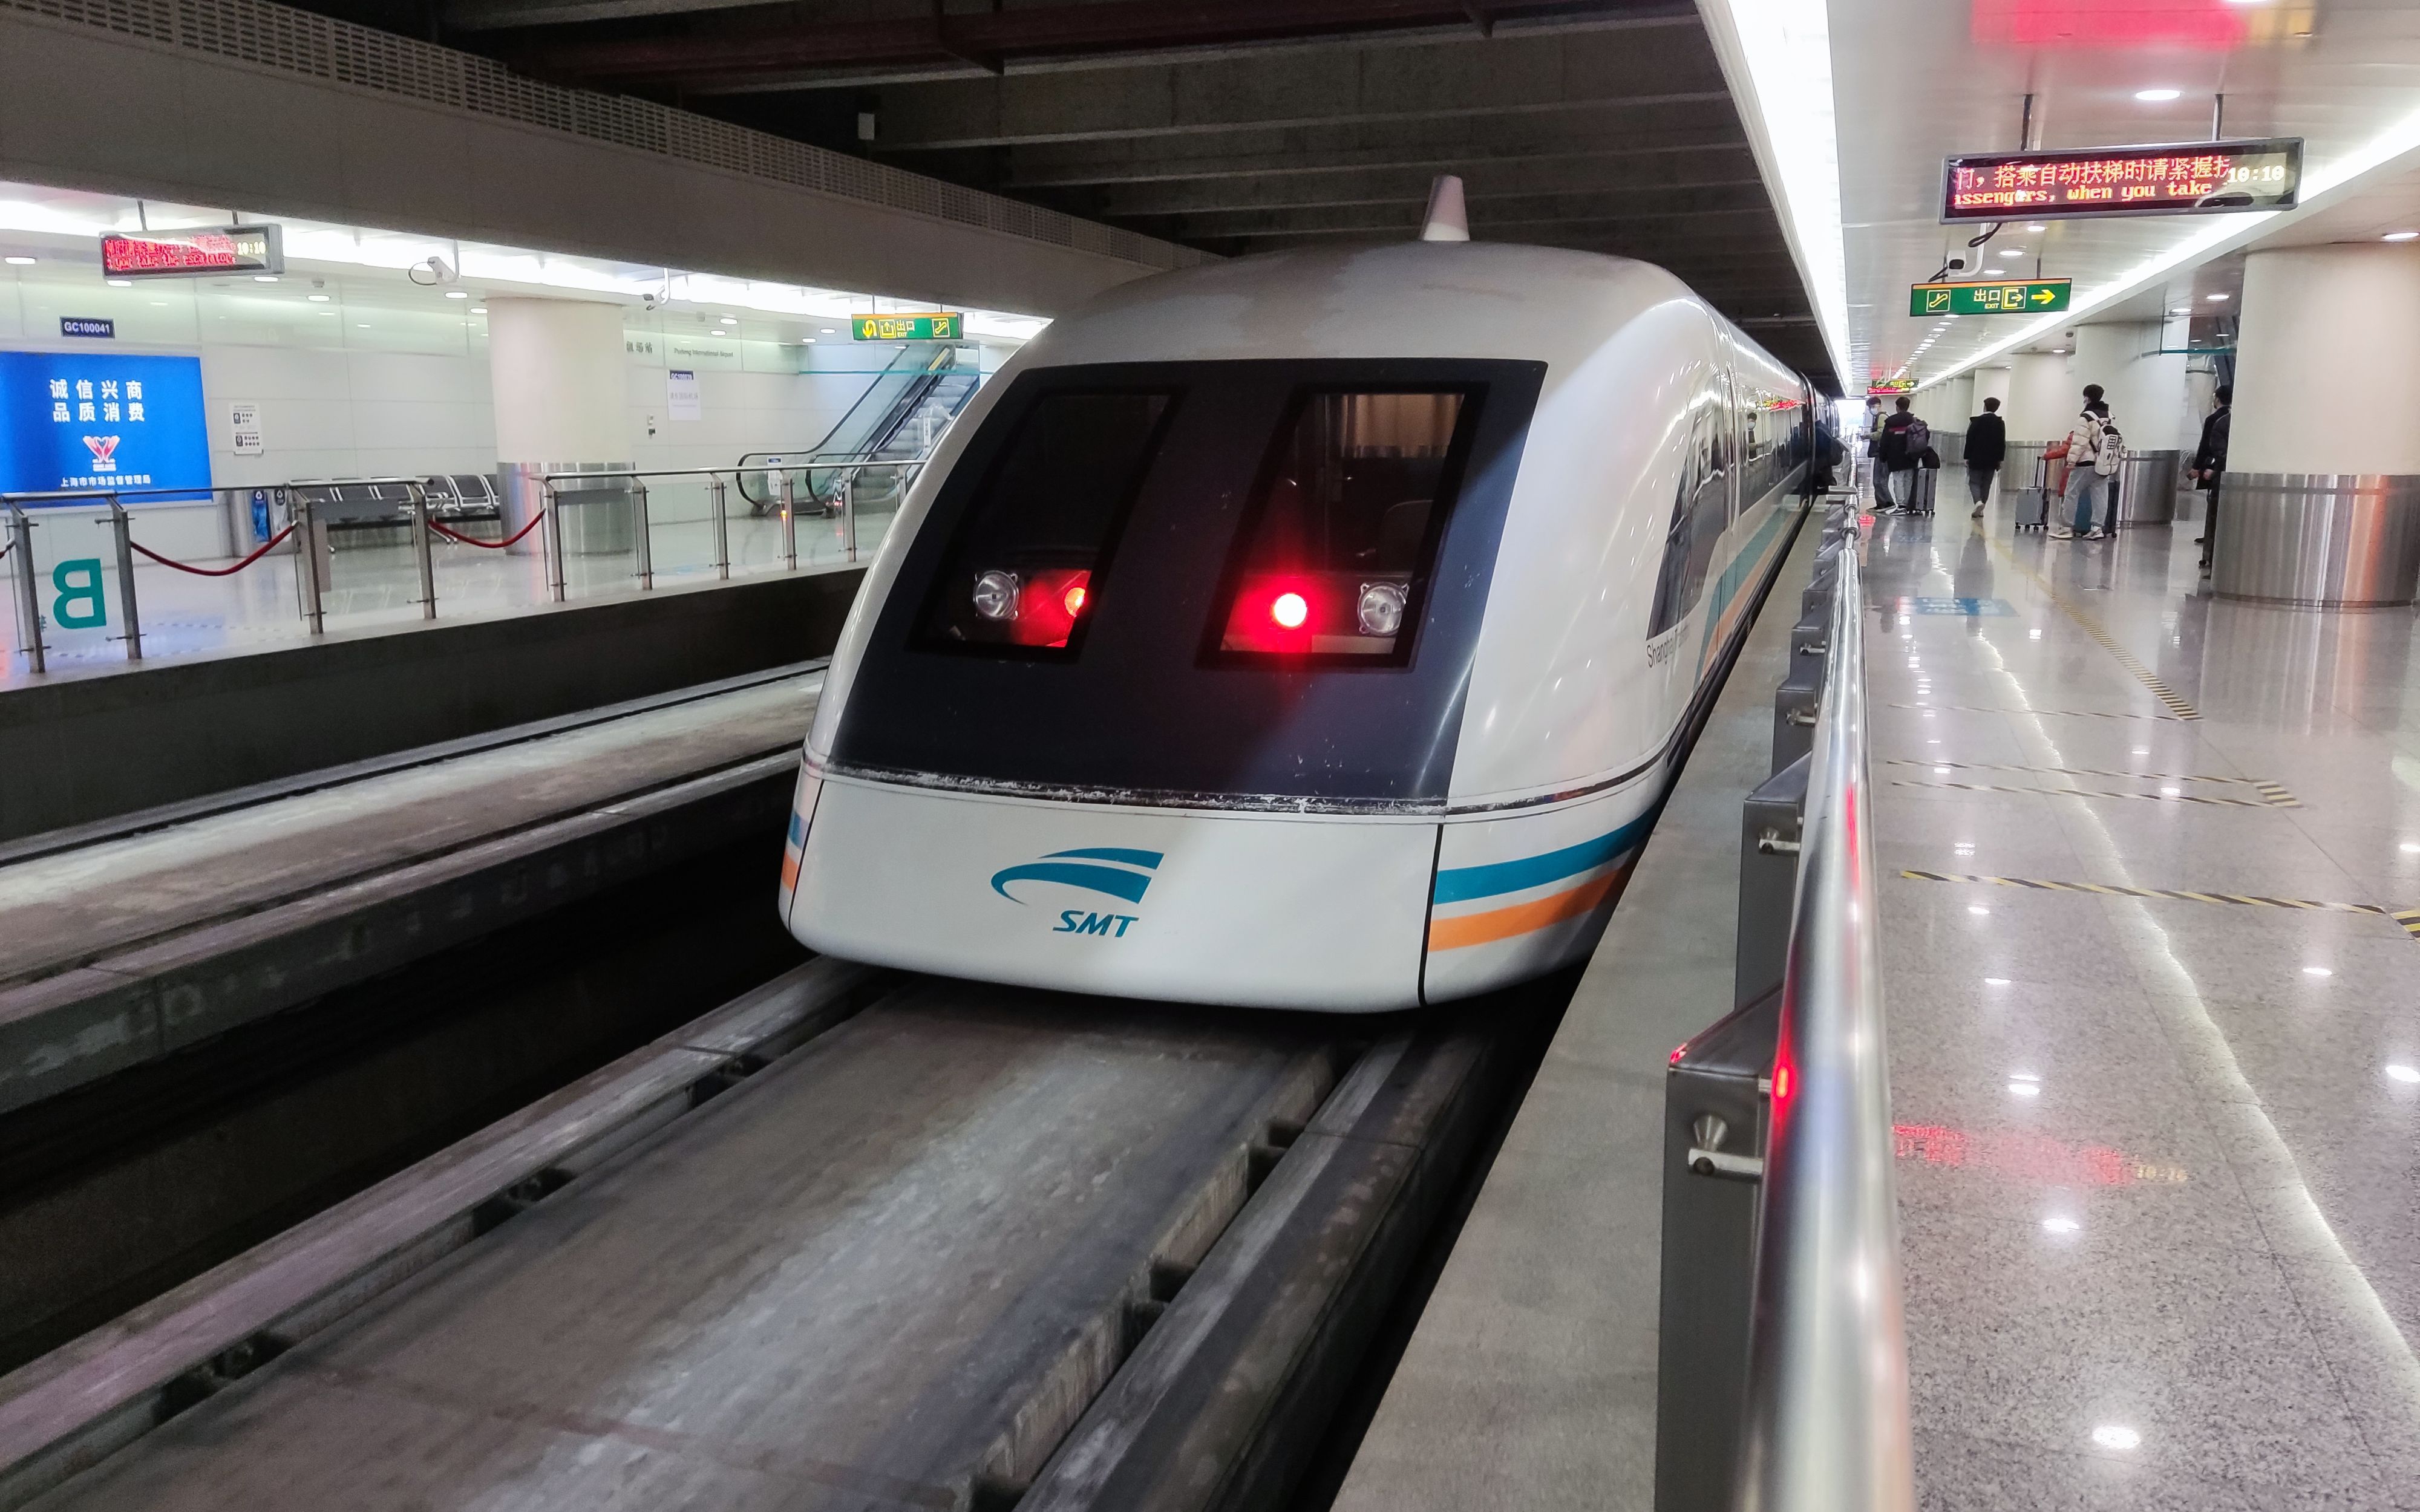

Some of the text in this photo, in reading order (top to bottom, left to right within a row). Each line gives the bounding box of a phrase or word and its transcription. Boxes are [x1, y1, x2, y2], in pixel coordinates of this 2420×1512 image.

[2227, 165, 2285, 183] 10:10
[2067, 184, 2113, 200] when
[2121, 185, 2156, 201] you
[2167, 181, 2212, 196] take
[237, 241, 266, 255] 10:10
[1974, 288, 2001, 302] 出口
[64, 321, 110, 333] GC100041
[897, 319, 915, 331] 出口
[50, 379, 143, 400] 诚信兴商
[53, 402, 145, 423] 品质消费
[1053, 910, 1139, 937] SMT
